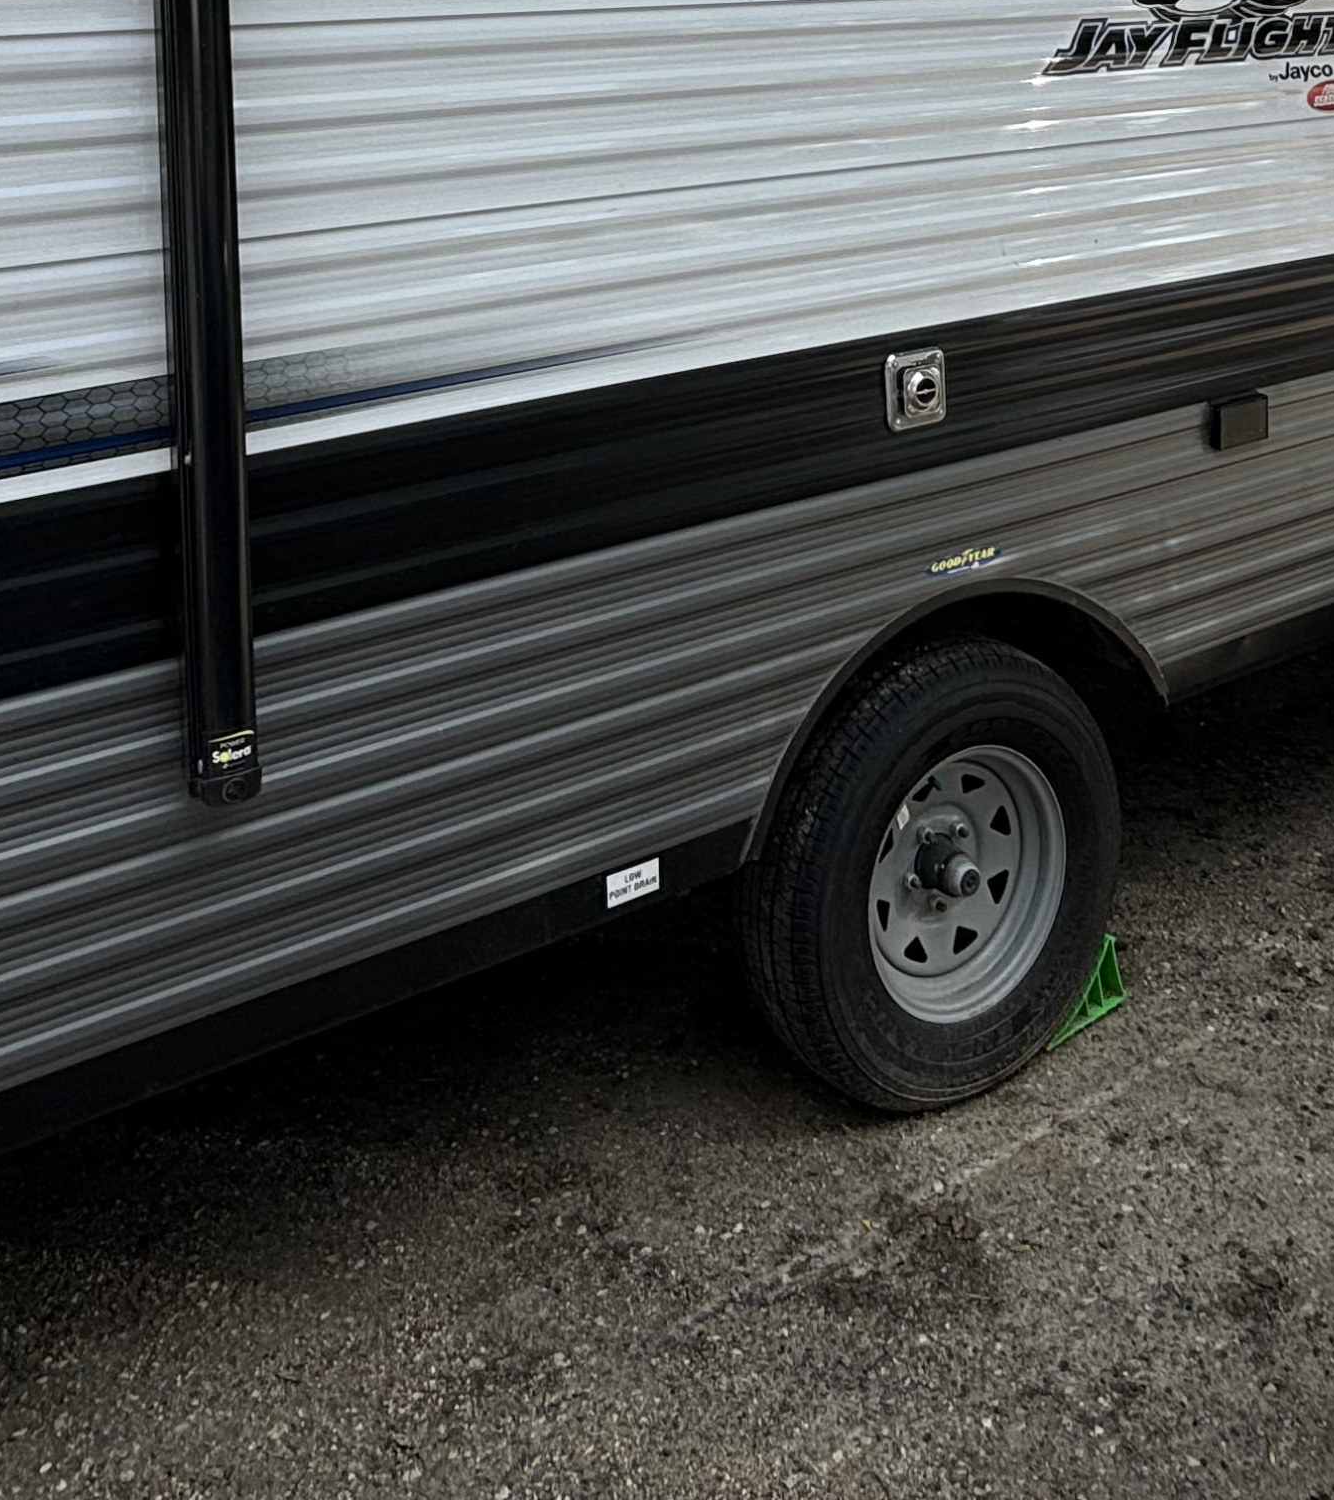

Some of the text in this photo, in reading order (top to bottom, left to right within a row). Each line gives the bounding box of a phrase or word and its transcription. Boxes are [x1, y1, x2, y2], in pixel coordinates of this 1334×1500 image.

[1041, 17, 1170, 76] JAY
[1278, 61, 1334, 82] Jayco
[624, 869, 642, 884] LOW
[609, 884, 632, 901] POINT
